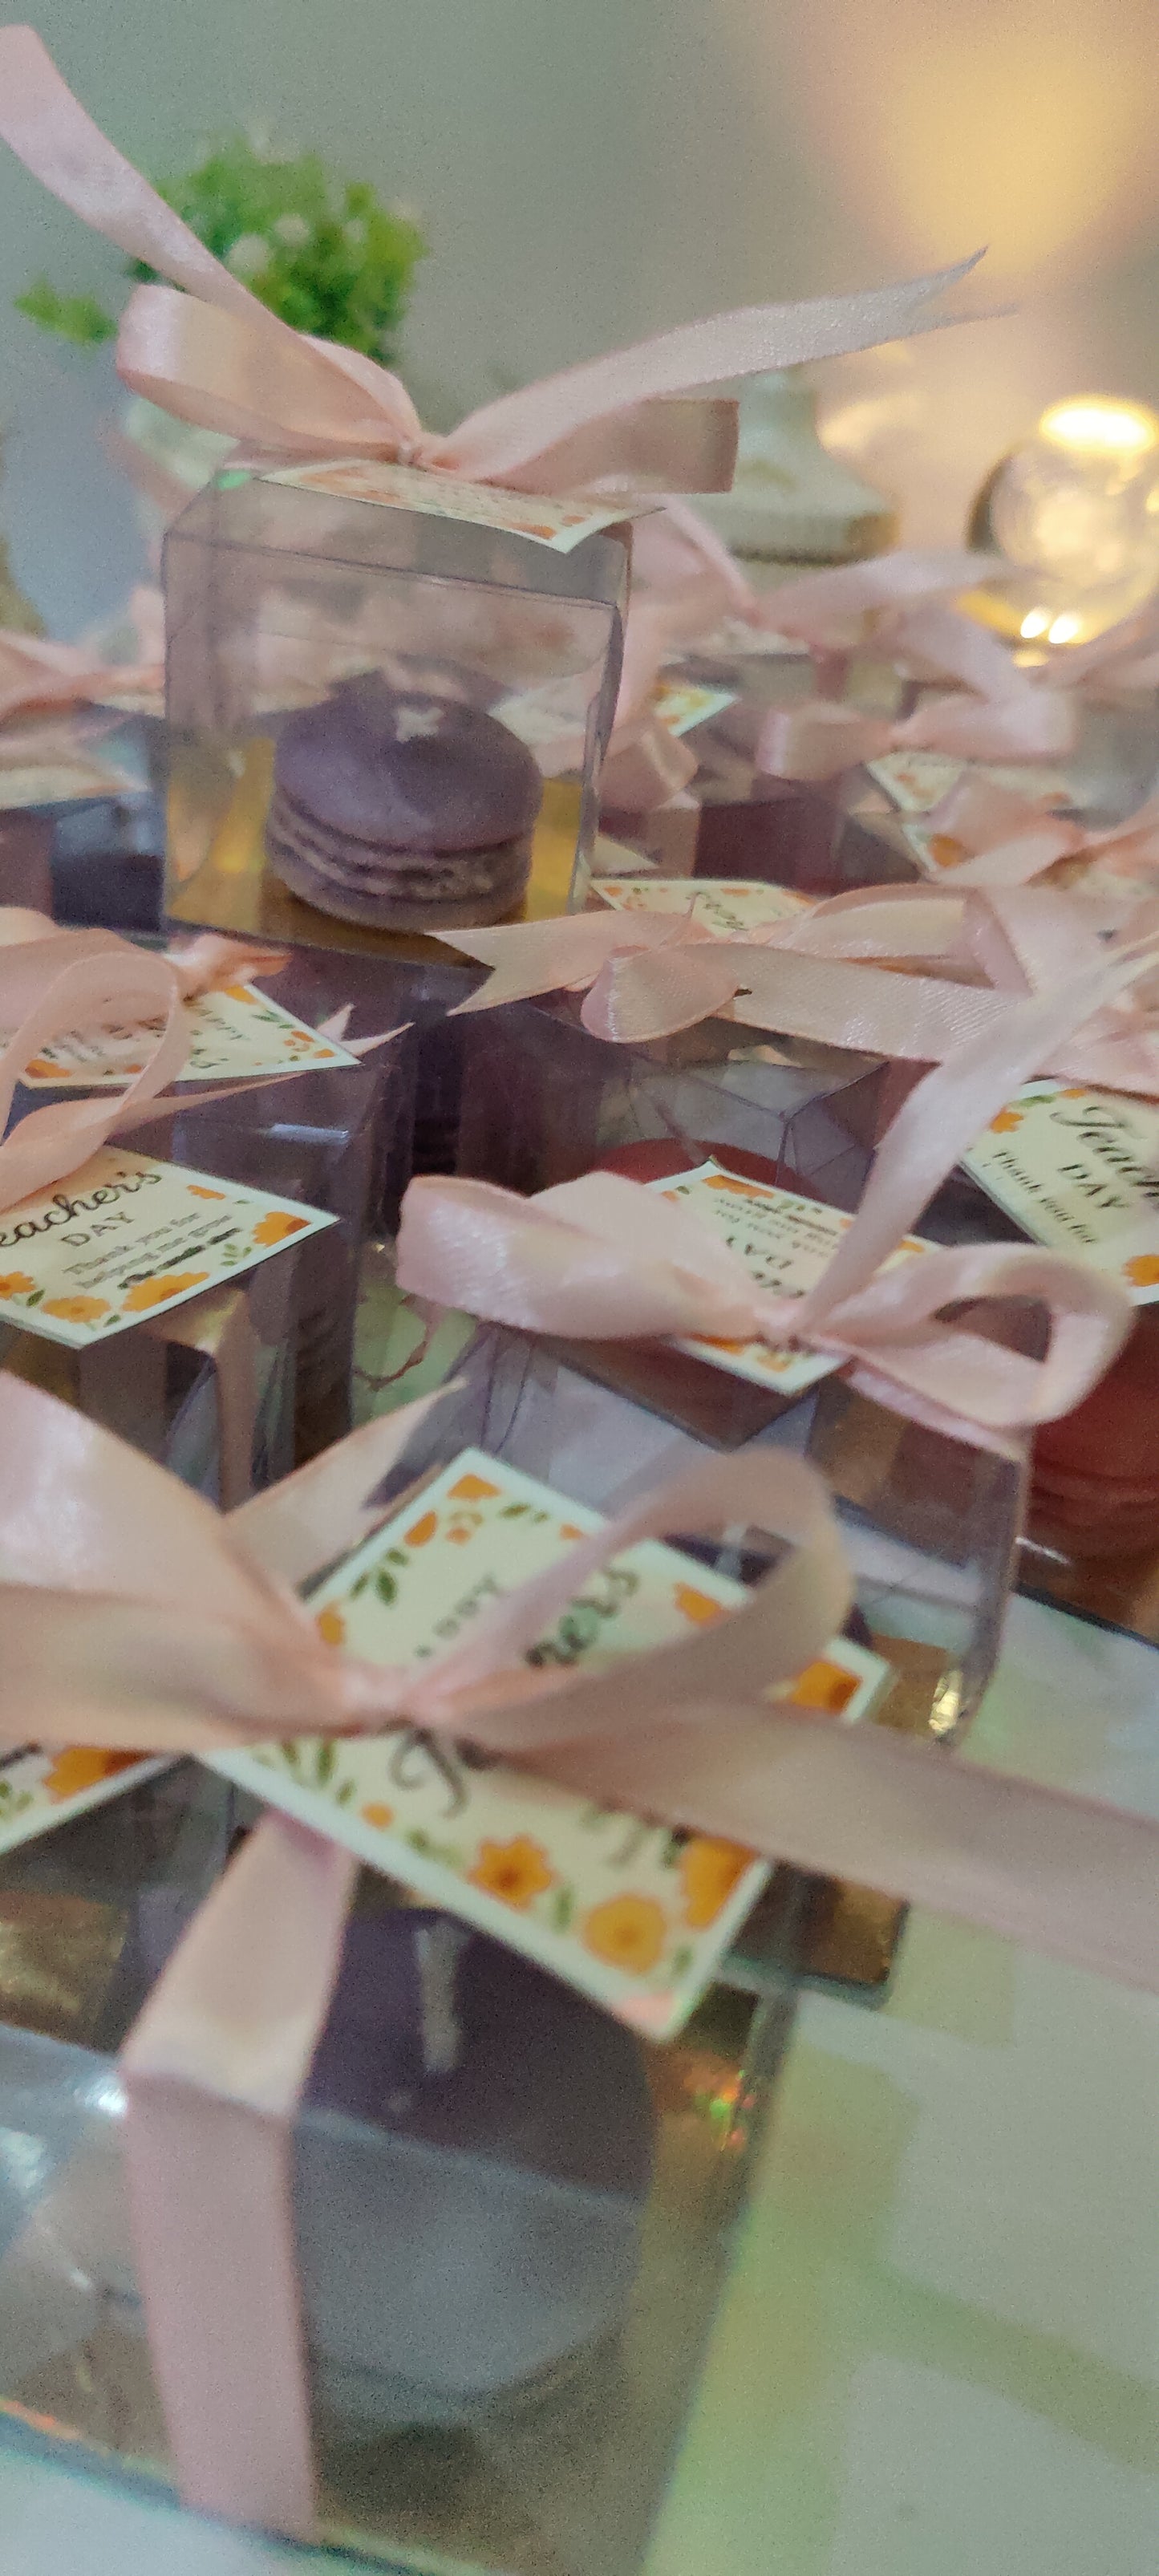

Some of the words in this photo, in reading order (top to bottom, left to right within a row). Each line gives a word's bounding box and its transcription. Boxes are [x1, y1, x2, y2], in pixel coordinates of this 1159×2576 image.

[992, 1148, 1042, 1195] Thank
[1057, 1163, 1131, 1210] DAY
[0, 1170, 162, 1247] eacher's
[60, 1211, 135, 1247] DAY
[62, 1244, 133, 1275] Thank
[136, 1226, 172, 1245] you
[169, 1212, 201, 1227] for
